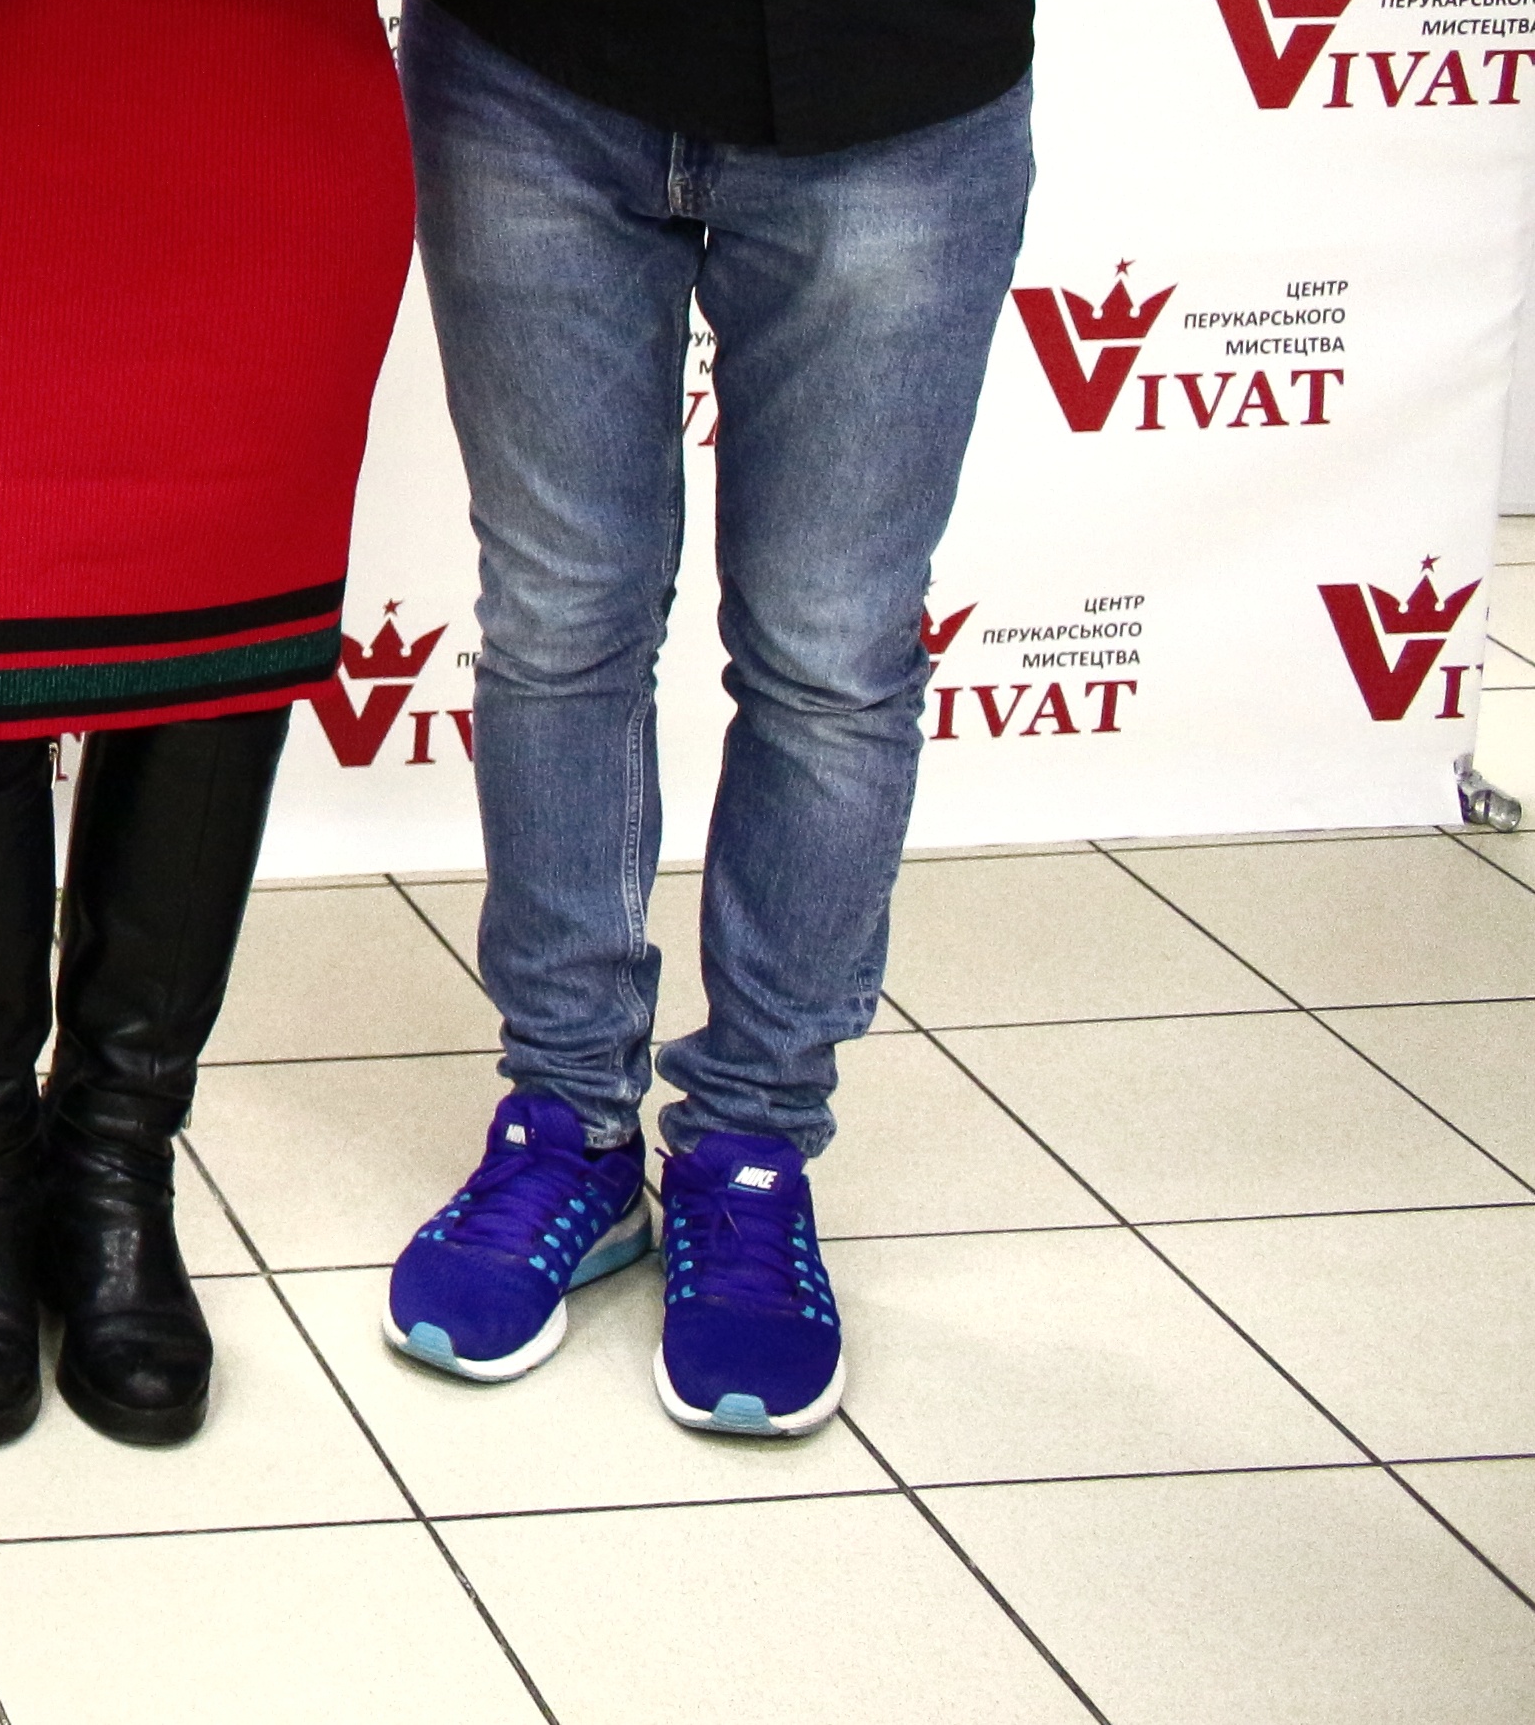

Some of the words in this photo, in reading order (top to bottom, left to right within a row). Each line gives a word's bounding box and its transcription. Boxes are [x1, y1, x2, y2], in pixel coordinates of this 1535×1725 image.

[1286, 280, 1349, 301] ЦЕНТР
[1184, 307, 1346, 329] ПЕРУКАРСЬКОГО
[1012, 279, 1344, 433] VIVAT
[1225, 336, 1345, 357] МИСТЕЦТВА
[1084, 594, 1145, 615] ЦЕНТР
[982, 621, 1143, 645] ПЕРУКАРСЬКОГО
[1022, 649, 1141, 669] МИСТЕЦТВА
[927, 680, 1138, 742] IVAT
[735, 1165, 778, 1190] NIKE
